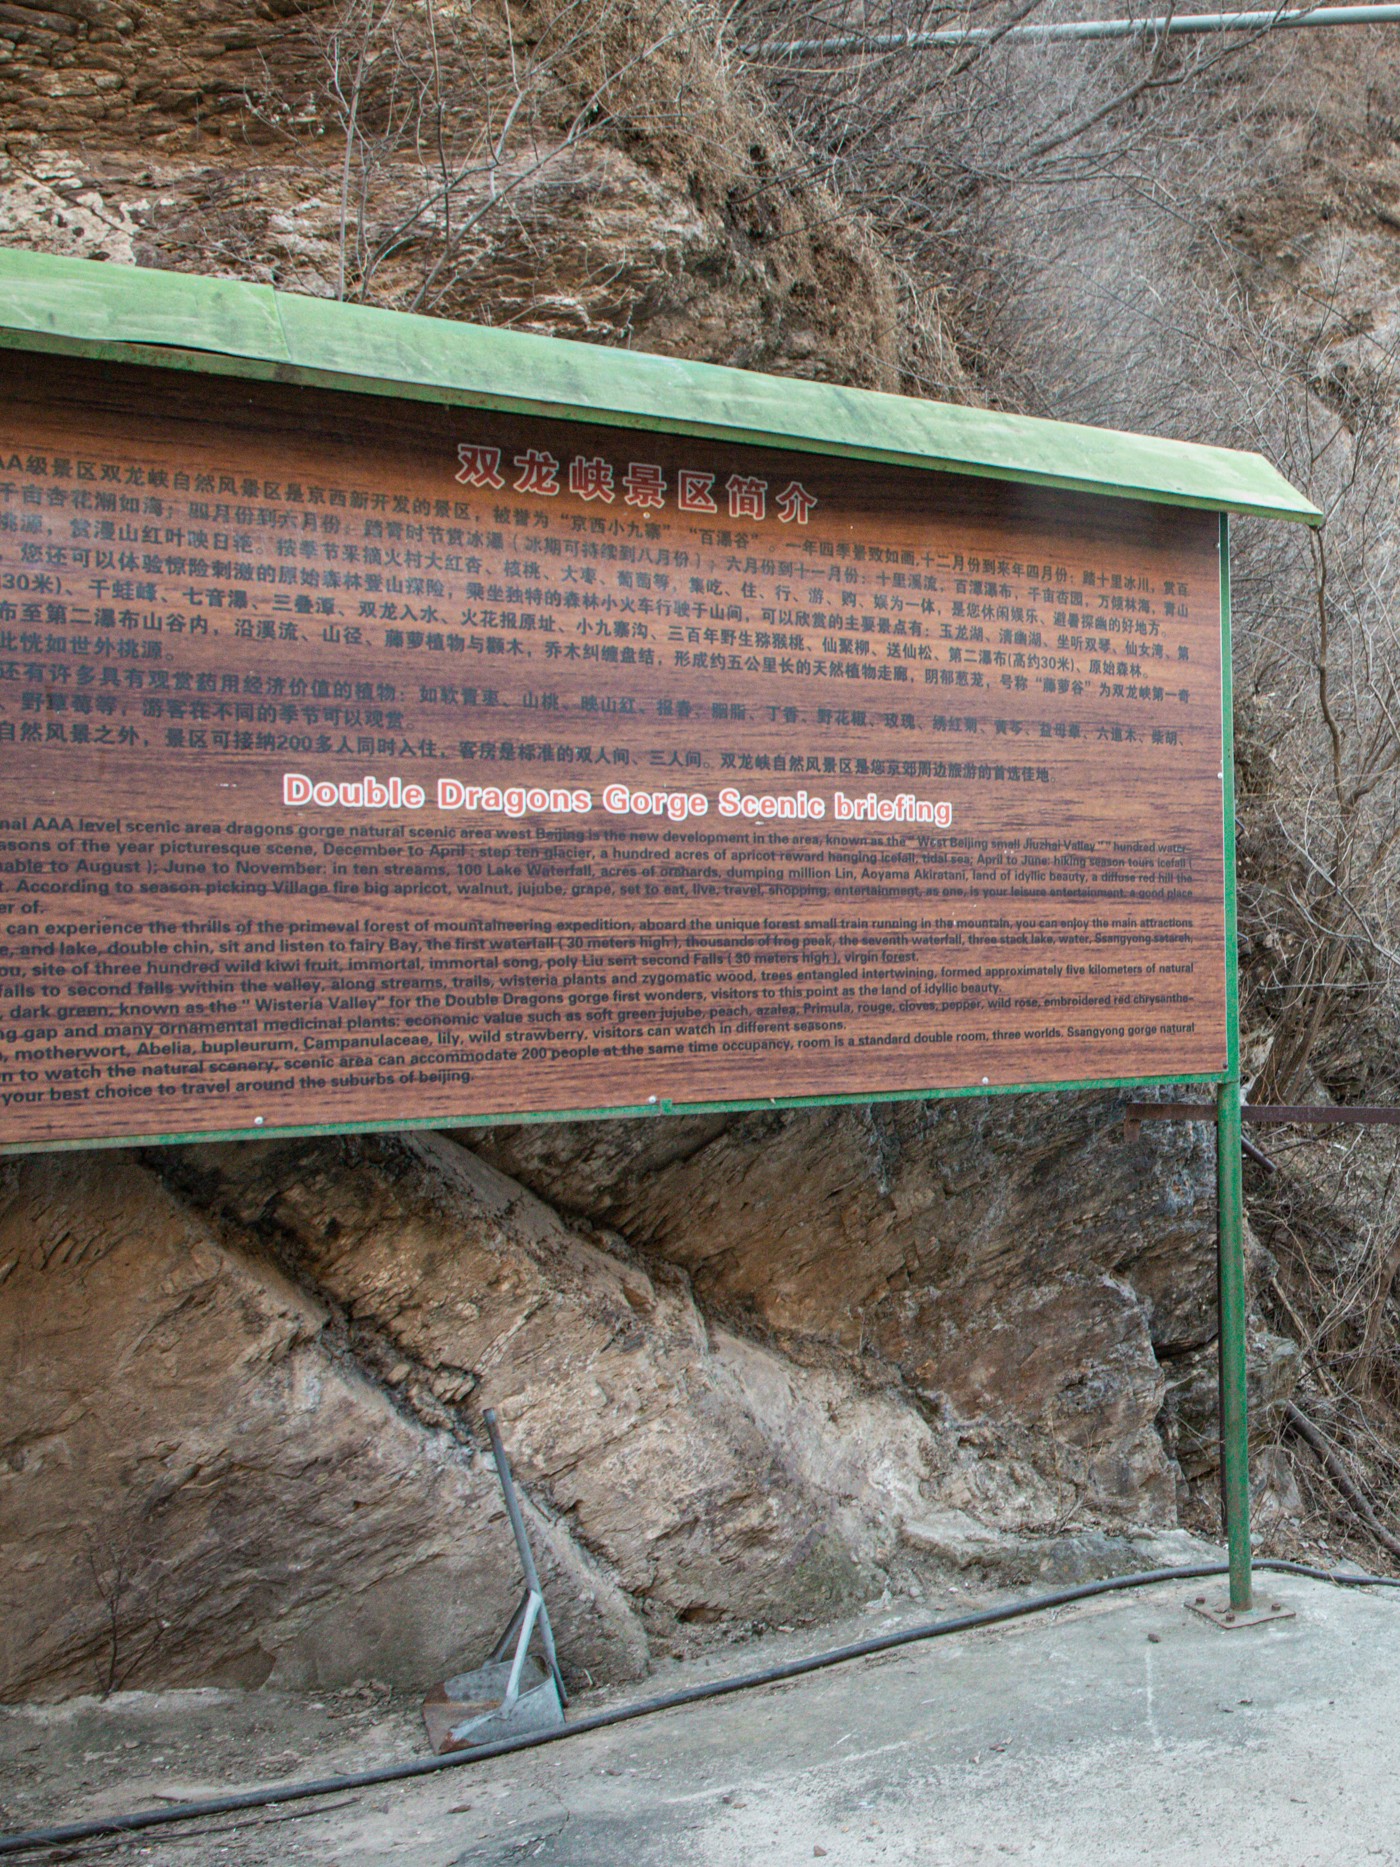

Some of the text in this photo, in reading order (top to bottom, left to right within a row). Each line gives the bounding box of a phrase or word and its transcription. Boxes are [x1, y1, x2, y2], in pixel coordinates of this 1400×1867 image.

[455, 443, 818, 525] 双龙峡景区简介
[0, 632, 175, 662] 此恍如世外桃源。
[283, 774, 952, 826] Double Dragons Gorge Scenic briefing
[51, 861, 68, 873] to
[76, 860, 140, 876] August
[164, 861, 206, 873] June
[212, 862, 229, 874] to
[333, 863, 347, 875] in
[354, 864, 378, 875] ten
[384, 864, 450, 877] streams,
[457, 864, 481, 876] 100
[488, 863, 521, 876] Lake
[601, 867, 637, 877] acres
[642, 867, 655, 877] of
[727, 867, 784, 880] dumping
[789, 868, 830, 879] million
[836, 868, 856, 881] Lin,
[862, 868, 909, 881] Aoyama
[972, 870, 996, 880] land
[1000, 870, 1010, 880] of
[1014, 870, 1045, 882] idyllic
[1050, 871, 1088, 884] beauty,
[1092, 874, 1098, 882] a
[1102, 871, 1135, 882] diffuse
[1139, 872, 1155, 882] red
[1158, 872, 1173, 883] hill
[7, 924, 38, 935] can
[46, 922, 142, 938] experience
[150, 922, 176, 933] the
[182, 921, 230, 932] thrills
[236, 921, 253, 934] of
[258, 921, 282, 932] the
[289, 919, 359, 936] primeval
[364, 920, 409, 932] forest
[415, 920, 429, 932] of
[557, 918, 634, 932] expedition,
[640, 920, 686, 930] aboard
[690, 919, 710, 930] the
[716, 920, 759, 932] unique
[764, 919, 800, 930] forest
[804, 918, 836, 929] small
[841, 919, 868, 929] train
[872, 918, 917, 931] running
[921, 919, 930, 928] in
[936, 919, 953, 928] the
[956, 918, 1012, 930] mountain,
[1016, 920, 1034, 931] you
[1039, 920, 1057, 928] can
[1061, 918, 1088, 930] enjoy
[1092, 919, 1109, 928] the
[1112, 919, 1136, 928] main
[1140, 918, 1192, 928] attractions
[41, 984, 60, 997] to
[68, 984, 131, 996] second
[138, 982, 173, 994] falls
[180, 981, 234, 994] within
[240, 980, 267, 992] the
[274, 979, 325, 993] valley,
[331, 978, 374, 992] along
[382, 978, 447, 990] streams,
[453, 976, 494, 988] trails,
[500, 974, 558, 987] wisteria
[563, 973, 606, 987] plants
[612, 971, 636, 983] and
[642, 970, 711, 986] zygomatic
[716, 970, 756, 983] wood,
[761, 970, 792, 981] trees
[798, 968, 858, 982] entangled
[941, 966, 981, 977] formed
[986, 964, 1062, 979] approximately
[1067, 964, 1084, 975] five
[1089, 964, 1142, 974] kilometers
[1146, 963, 1155, 973] of
[1159, 962, 1193, 973] natural
[16, 1044, 130, 1060] motherwort,
[138, 1042, 196, 1056] Abelia,
[202, 1040, 298, 1055] bupleurum,
[438, 1031, 464, 1046] lily,
[469, 1030, 500, 1042] wild
[506, 1029, 588, 1044] strawberry,
[593, 1025, 643, 1039] visitors
[648, 1026, 670, 1036] can
[676, 1023, 715, 1035] watch
[720, 1023, 731, 1034] in
[736, 1021, 790, 1033] different
[794, 1020, 846, 1032] seasons.
[2, 1070, 474, 1106] your best choice to travel around the suburbs of beijing.
